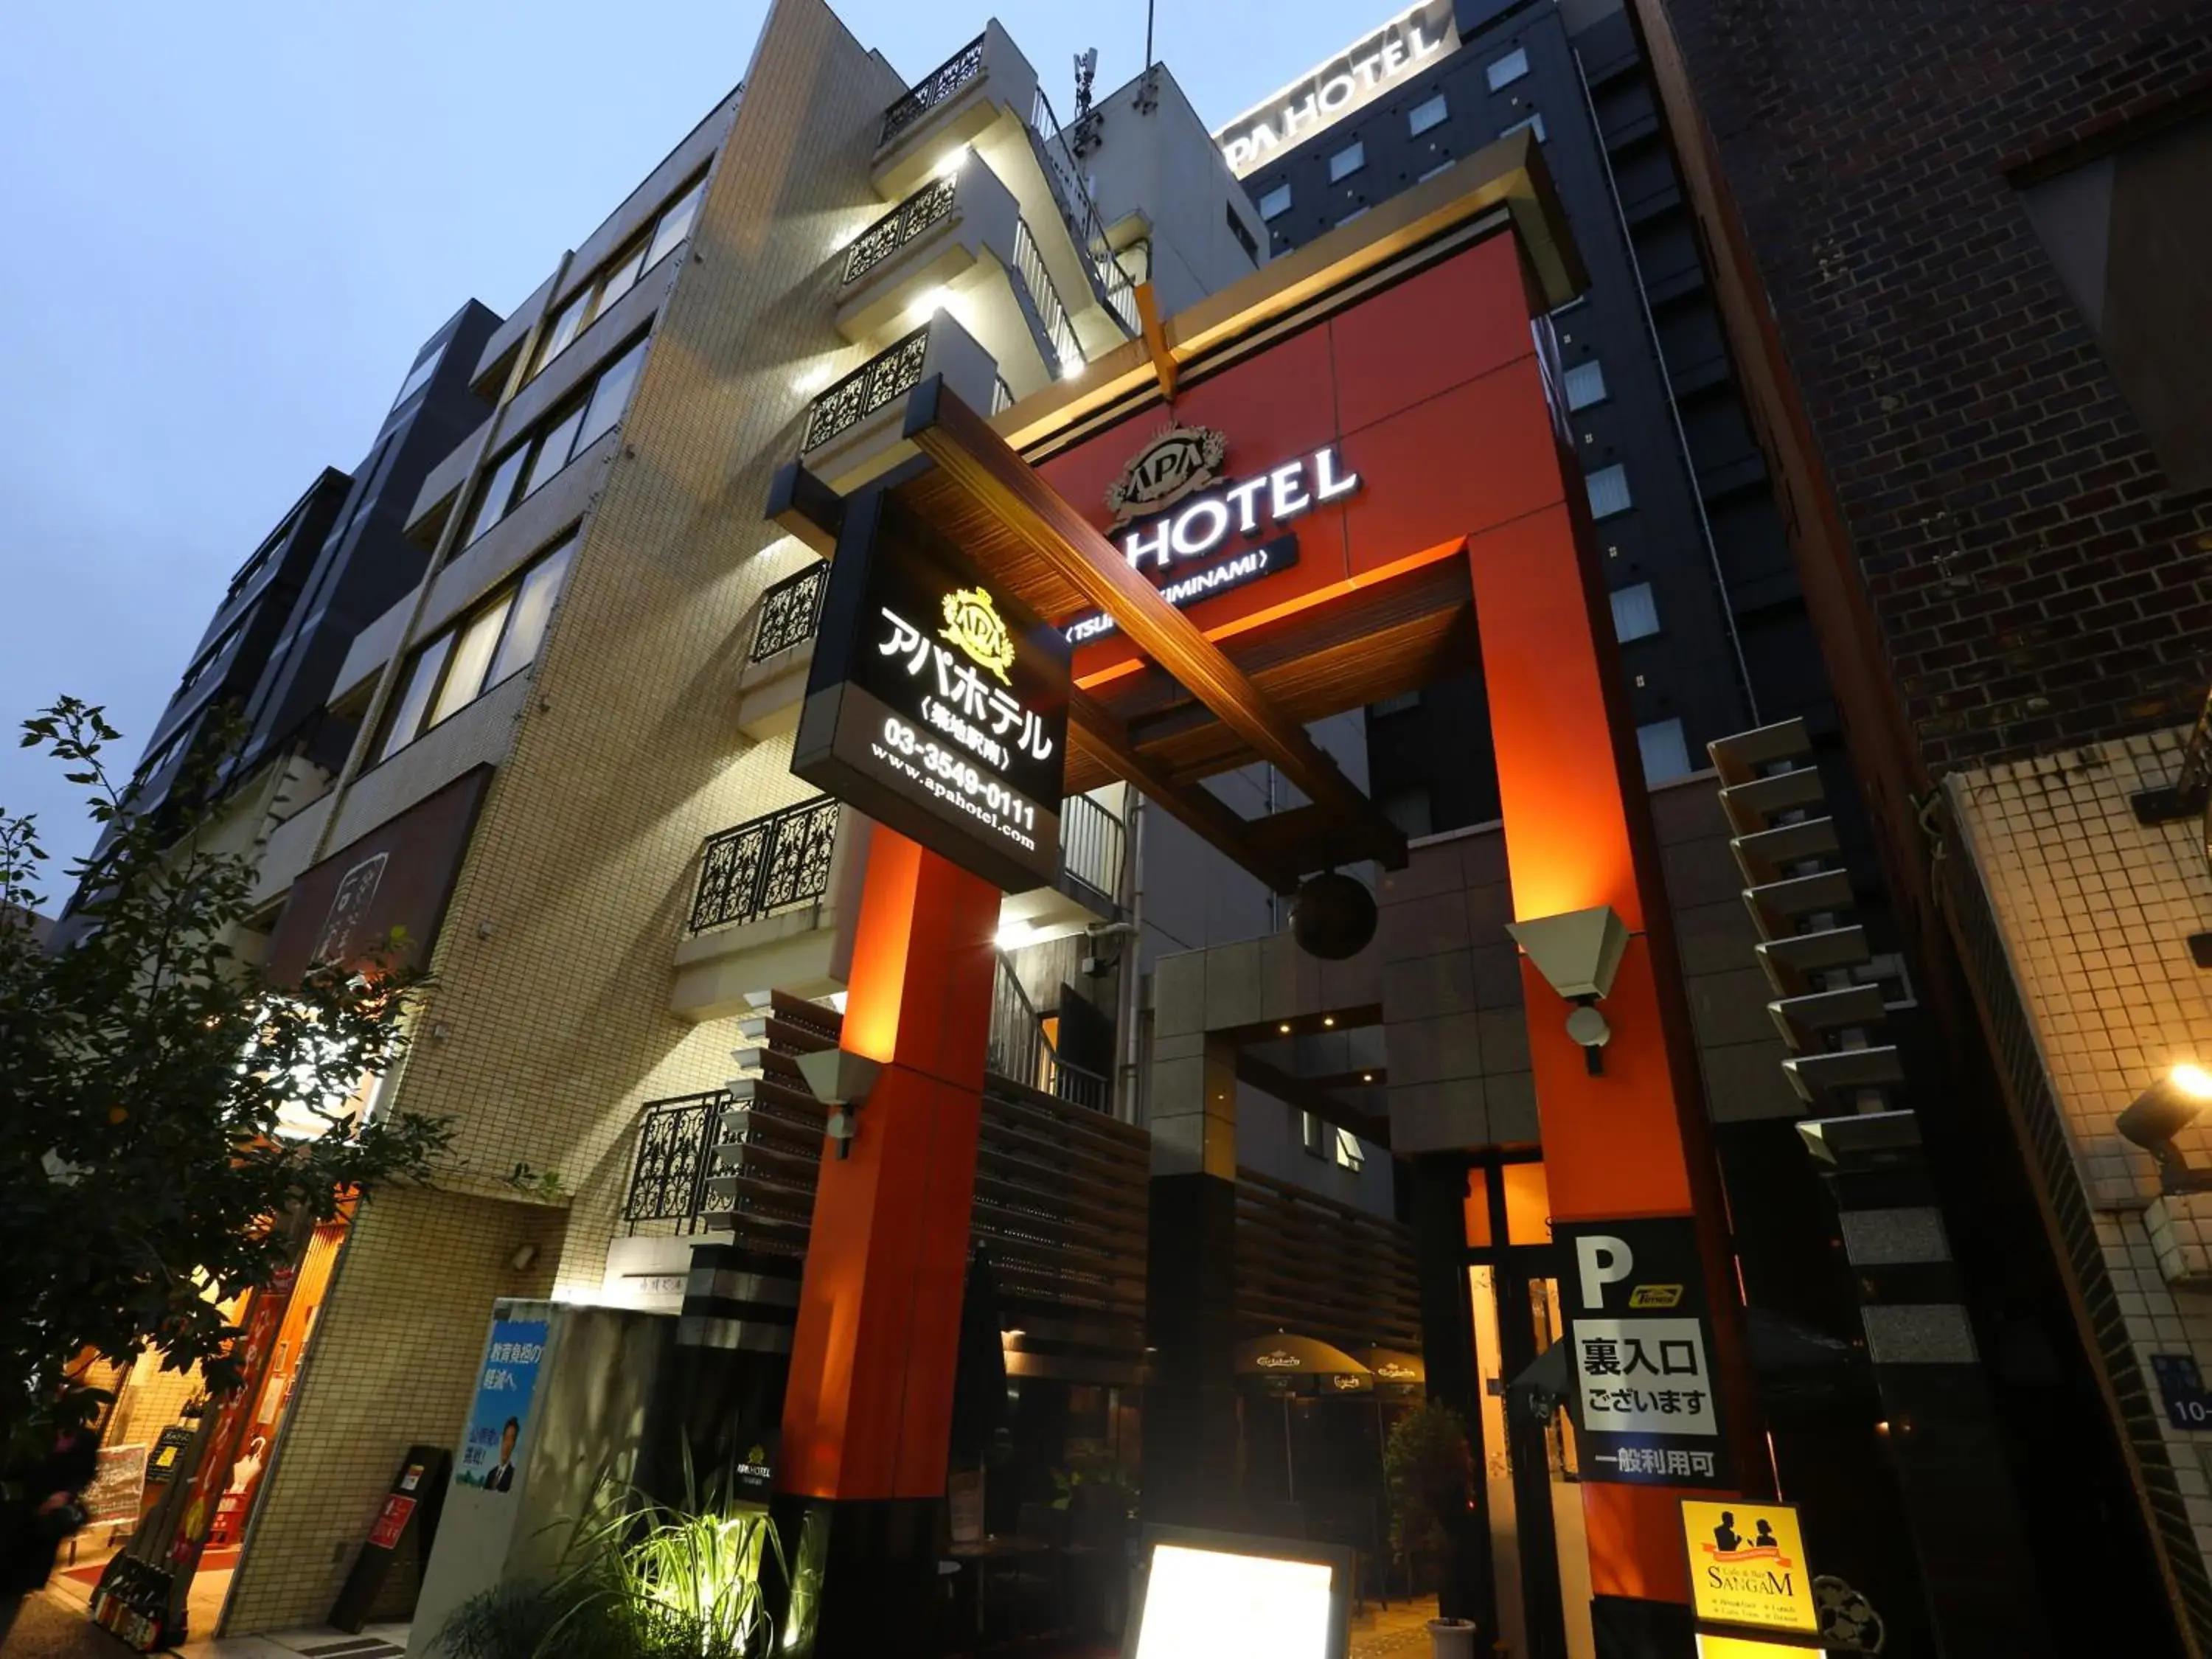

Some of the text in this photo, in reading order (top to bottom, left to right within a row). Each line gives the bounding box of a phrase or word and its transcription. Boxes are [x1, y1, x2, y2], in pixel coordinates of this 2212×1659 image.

[1222, 27, 1440, 171] PA HOTEL
[1126, 442, 1205, 498] APA
[1125, 448, 1358, 570] HOTEL
[956, 607, 1002, 652] APA
[877, 607, 1053, 760] アパホテル
[872, 743, 1036, 852] www.apahotel.com
[884, 717, 1036, 831] 03-3549-0111
[1575, 1235, 1634, 1309] P
[1581, 1337, 1699, 1377] 裏入口
[1589, 1388, 1706, 1415] ございます
[1595, 1447, 1715, 1478] 一般利用可
[1707, 1565, 1794, 1597] SANGAM
